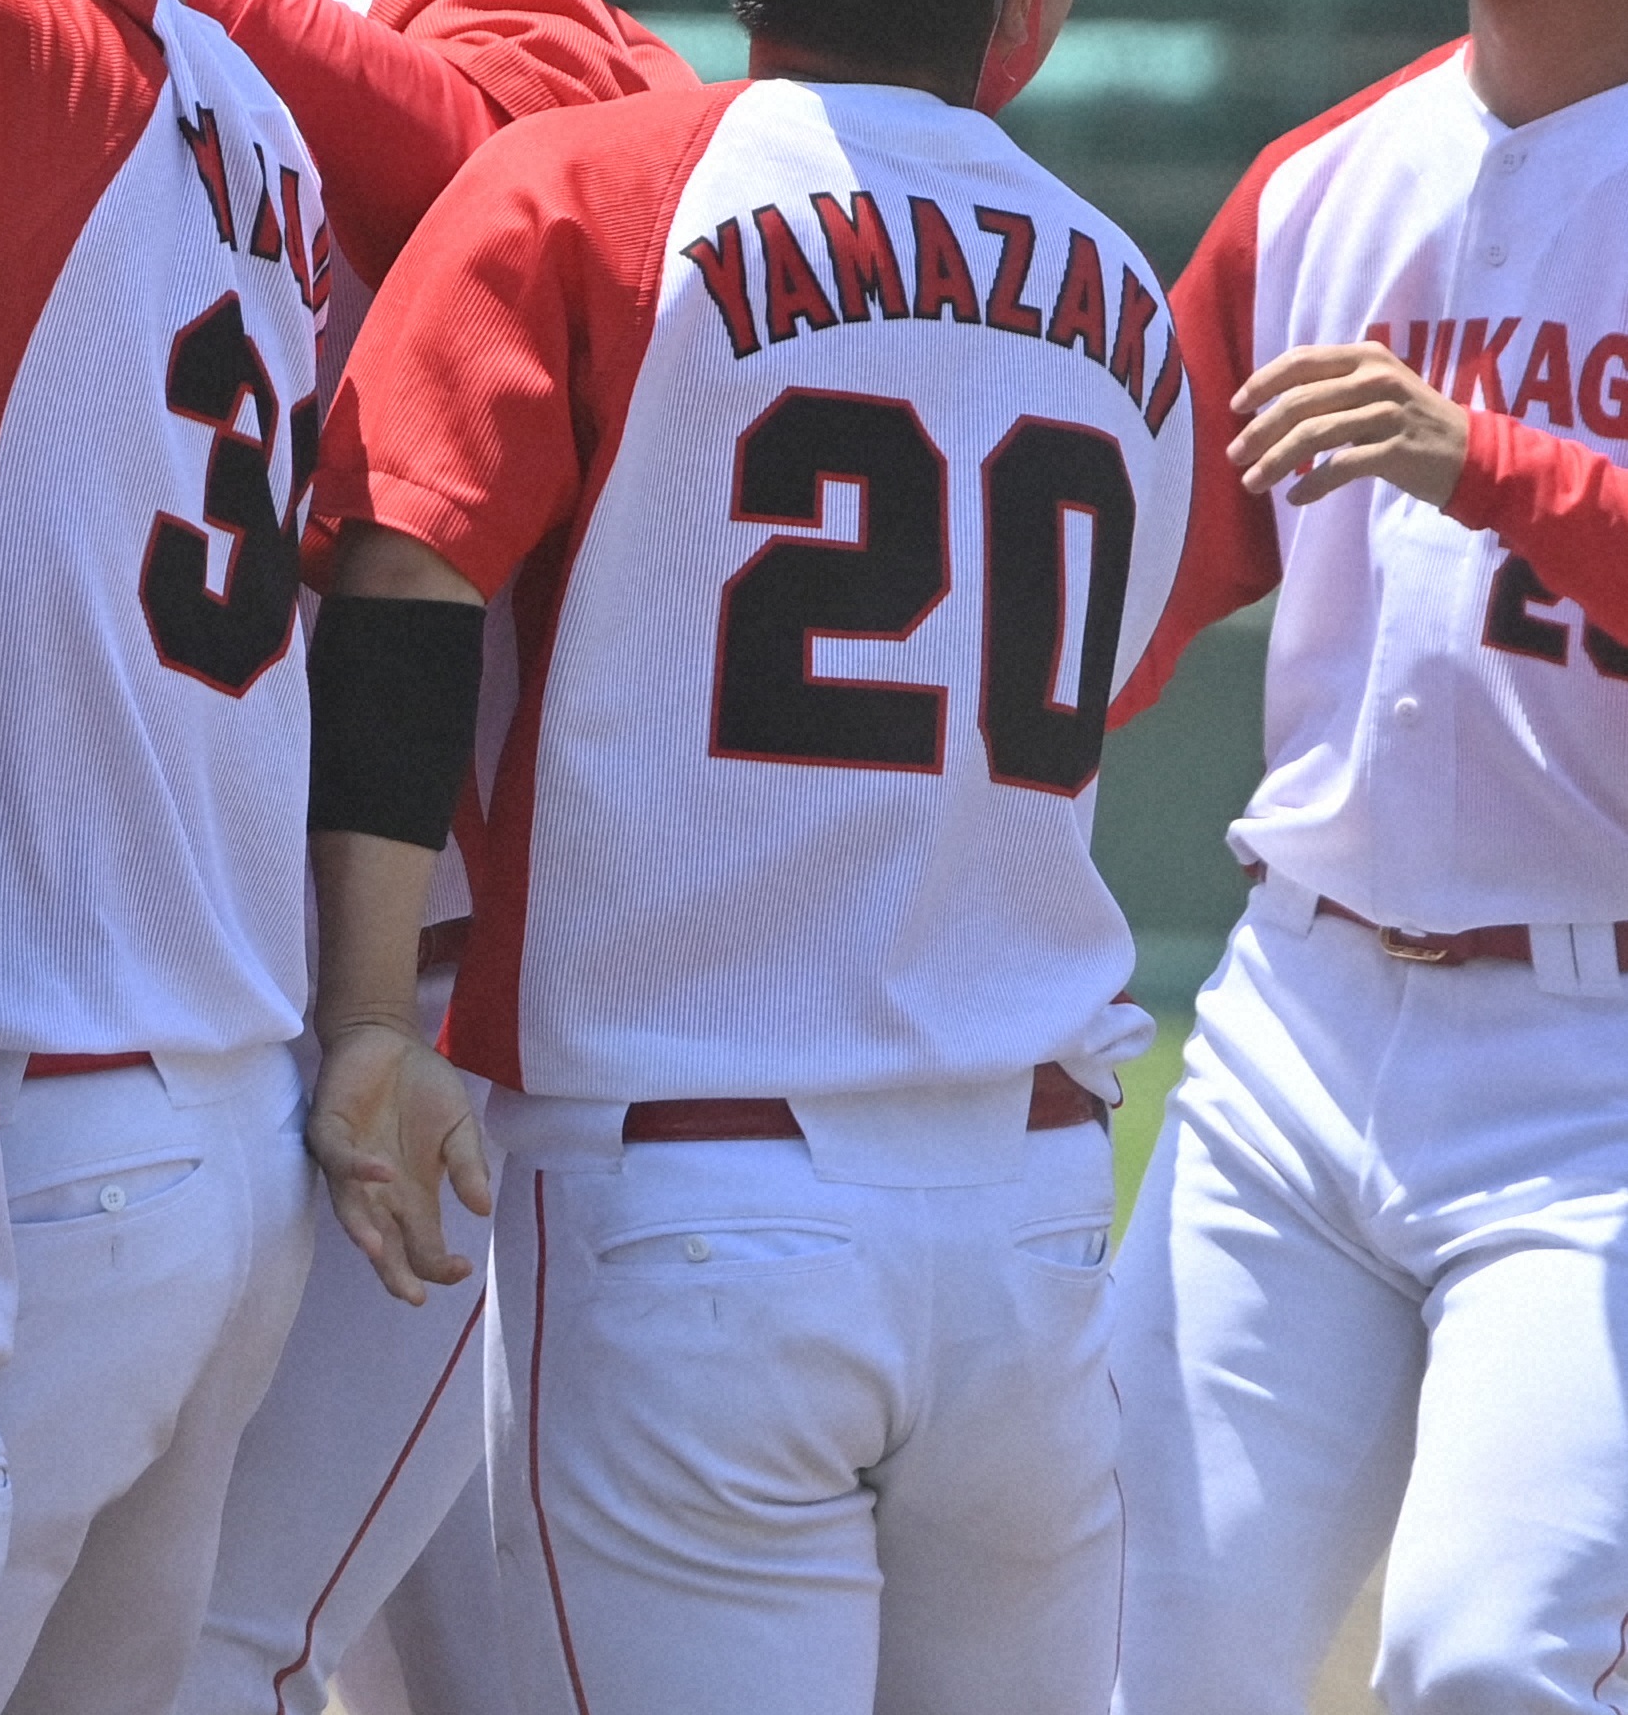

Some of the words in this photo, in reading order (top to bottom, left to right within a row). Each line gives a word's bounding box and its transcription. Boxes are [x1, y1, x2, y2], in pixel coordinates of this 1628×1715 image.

[679, 191, 1185, 439] YAMAZAKI
[1364, 316, 1628, 439] HIKAG
[708, 386, 1136, 798] 20
